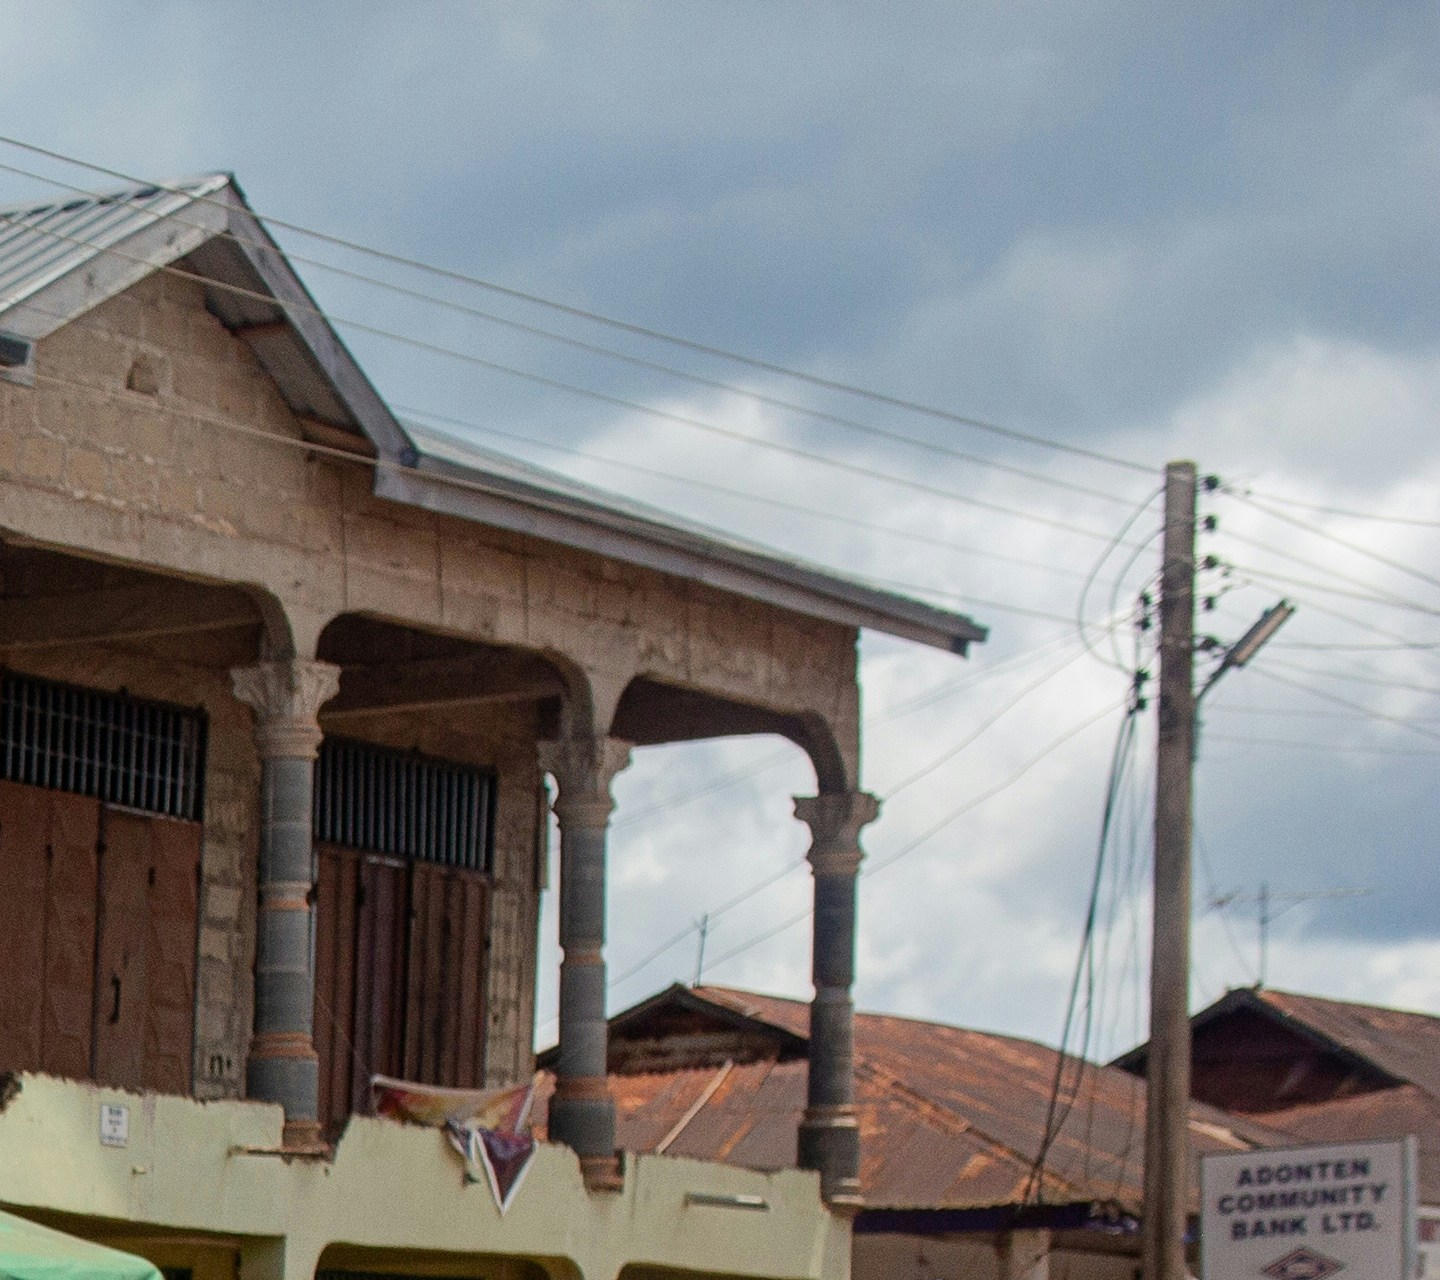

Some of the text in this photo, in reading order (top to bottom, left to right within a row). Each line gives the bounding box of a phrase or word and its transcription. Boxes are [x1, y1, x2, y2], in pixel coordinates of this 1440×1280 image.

[1236, 1158, 1372, 1187] ADONTEN
[1217, 1182, 1388, 1216] COMMUNITY
[1231, 1211, 1381, 1242] BANK LTD.
